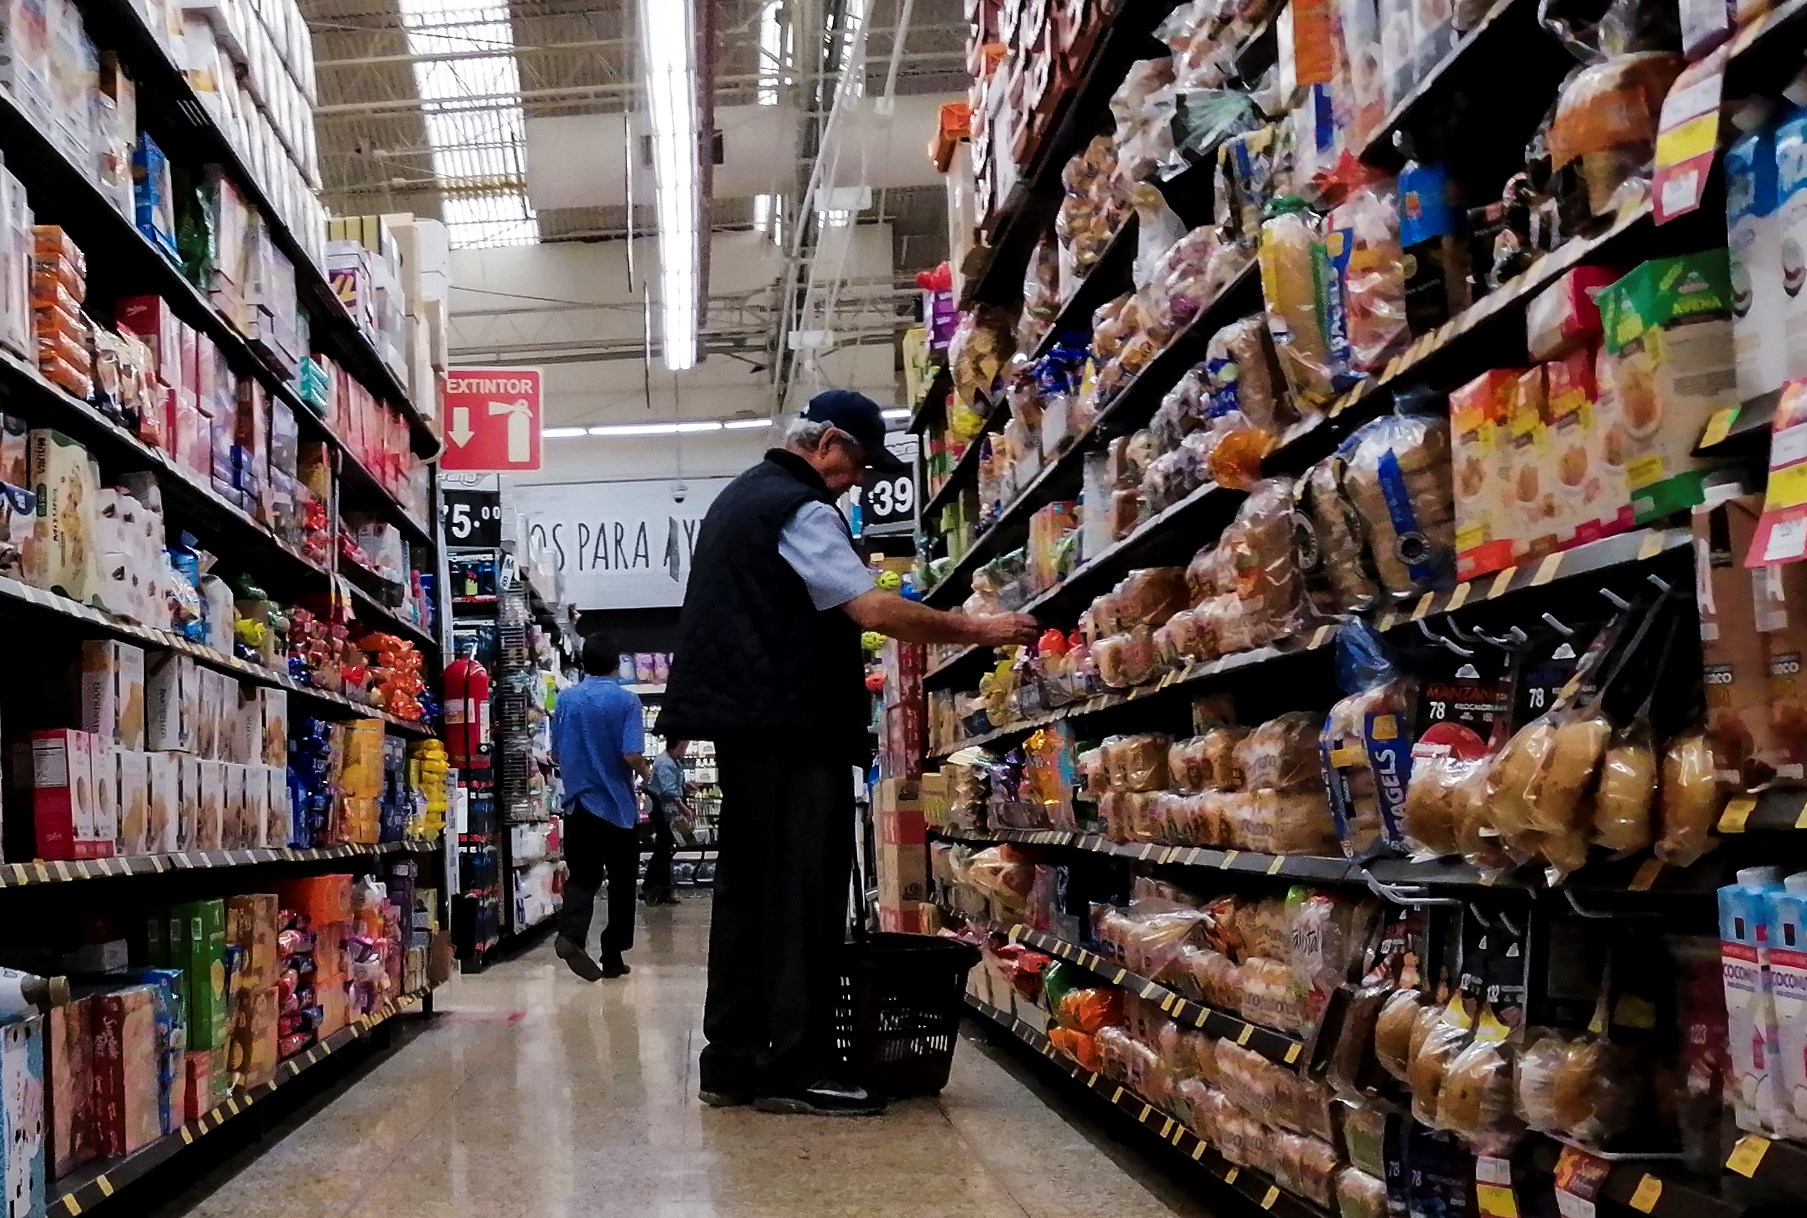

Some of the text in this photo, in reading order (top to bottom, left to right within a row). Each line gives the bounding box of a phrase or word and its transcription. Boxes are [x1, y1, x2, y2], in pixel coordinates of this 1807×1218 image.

[446, 378, 533, 394] EXTINTOR
[443, 503, 501, 538] 5.00
[578, 521, 649, 572] PARA
[1529, 687, 1545, 709] 78
[1429, 701, 1446, 720] 78
[1411, 1168, 1422, 1187] 78
